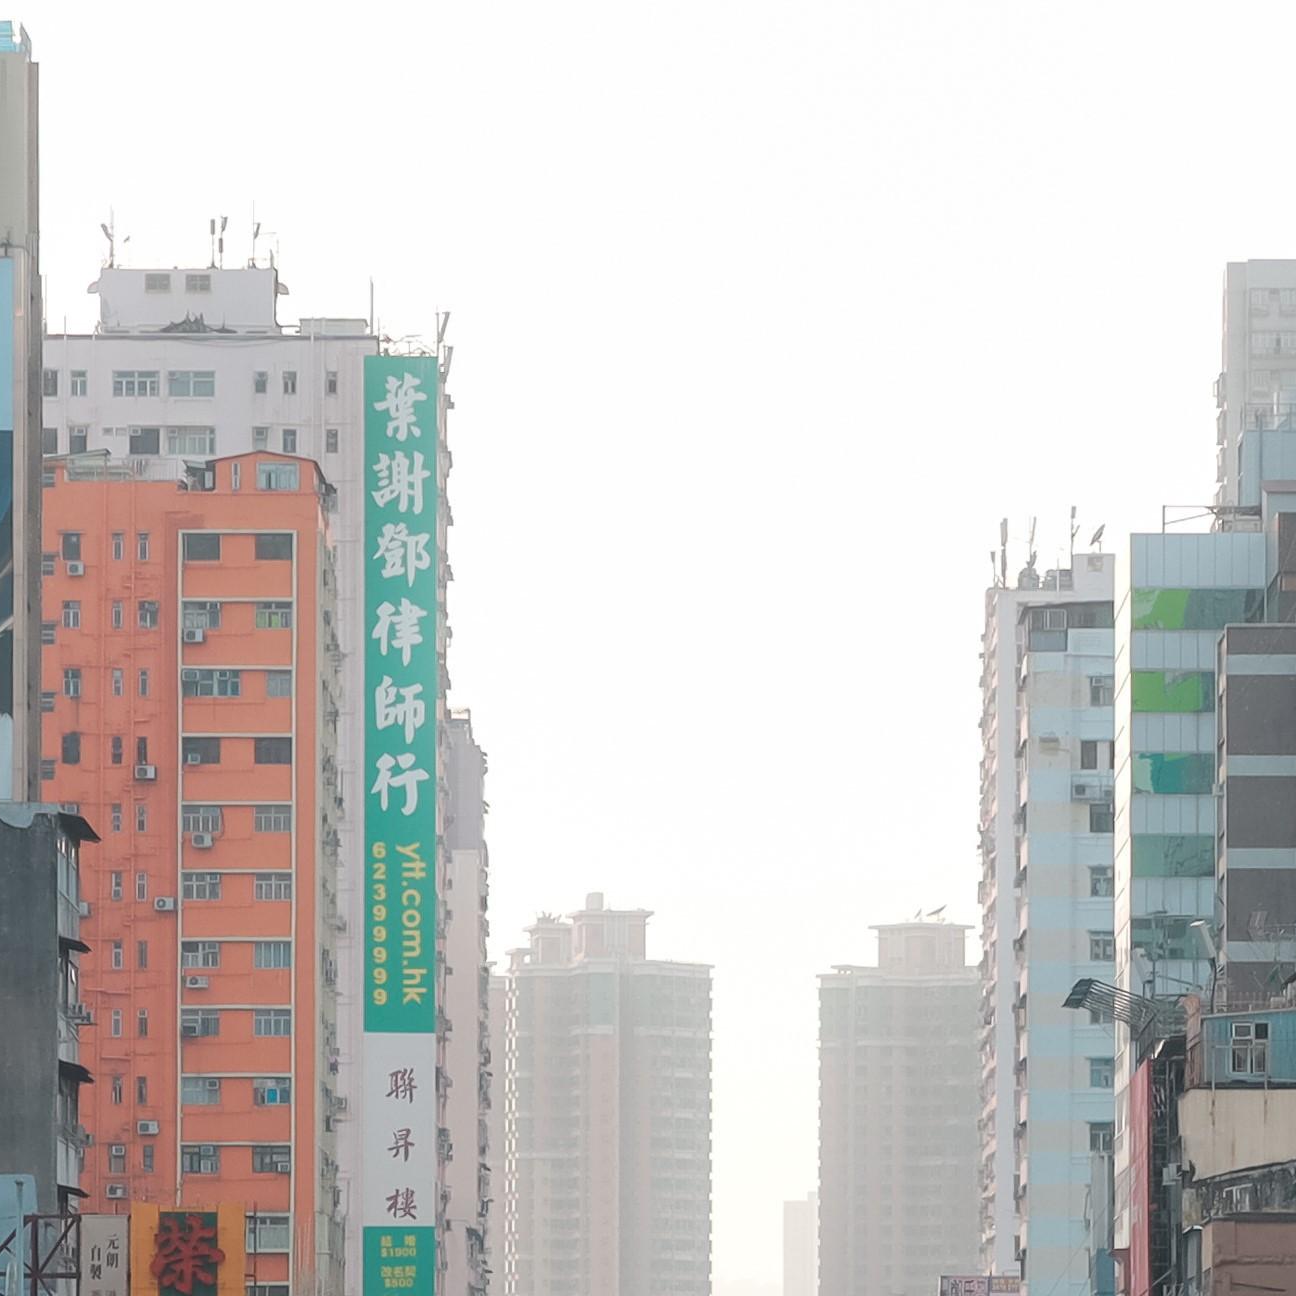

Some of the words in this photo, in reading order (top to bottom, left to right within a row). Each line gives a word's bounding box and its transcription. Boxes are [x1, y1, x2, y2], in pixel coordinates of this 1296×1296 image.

[371, 373, 431, 817] 葉謝鄧律師行
[371, 841, 387, 1005] 62399999
[395, 841, 422, 1005] ytt.com.hk
[106, 1234, 119, 1269] 元朗
